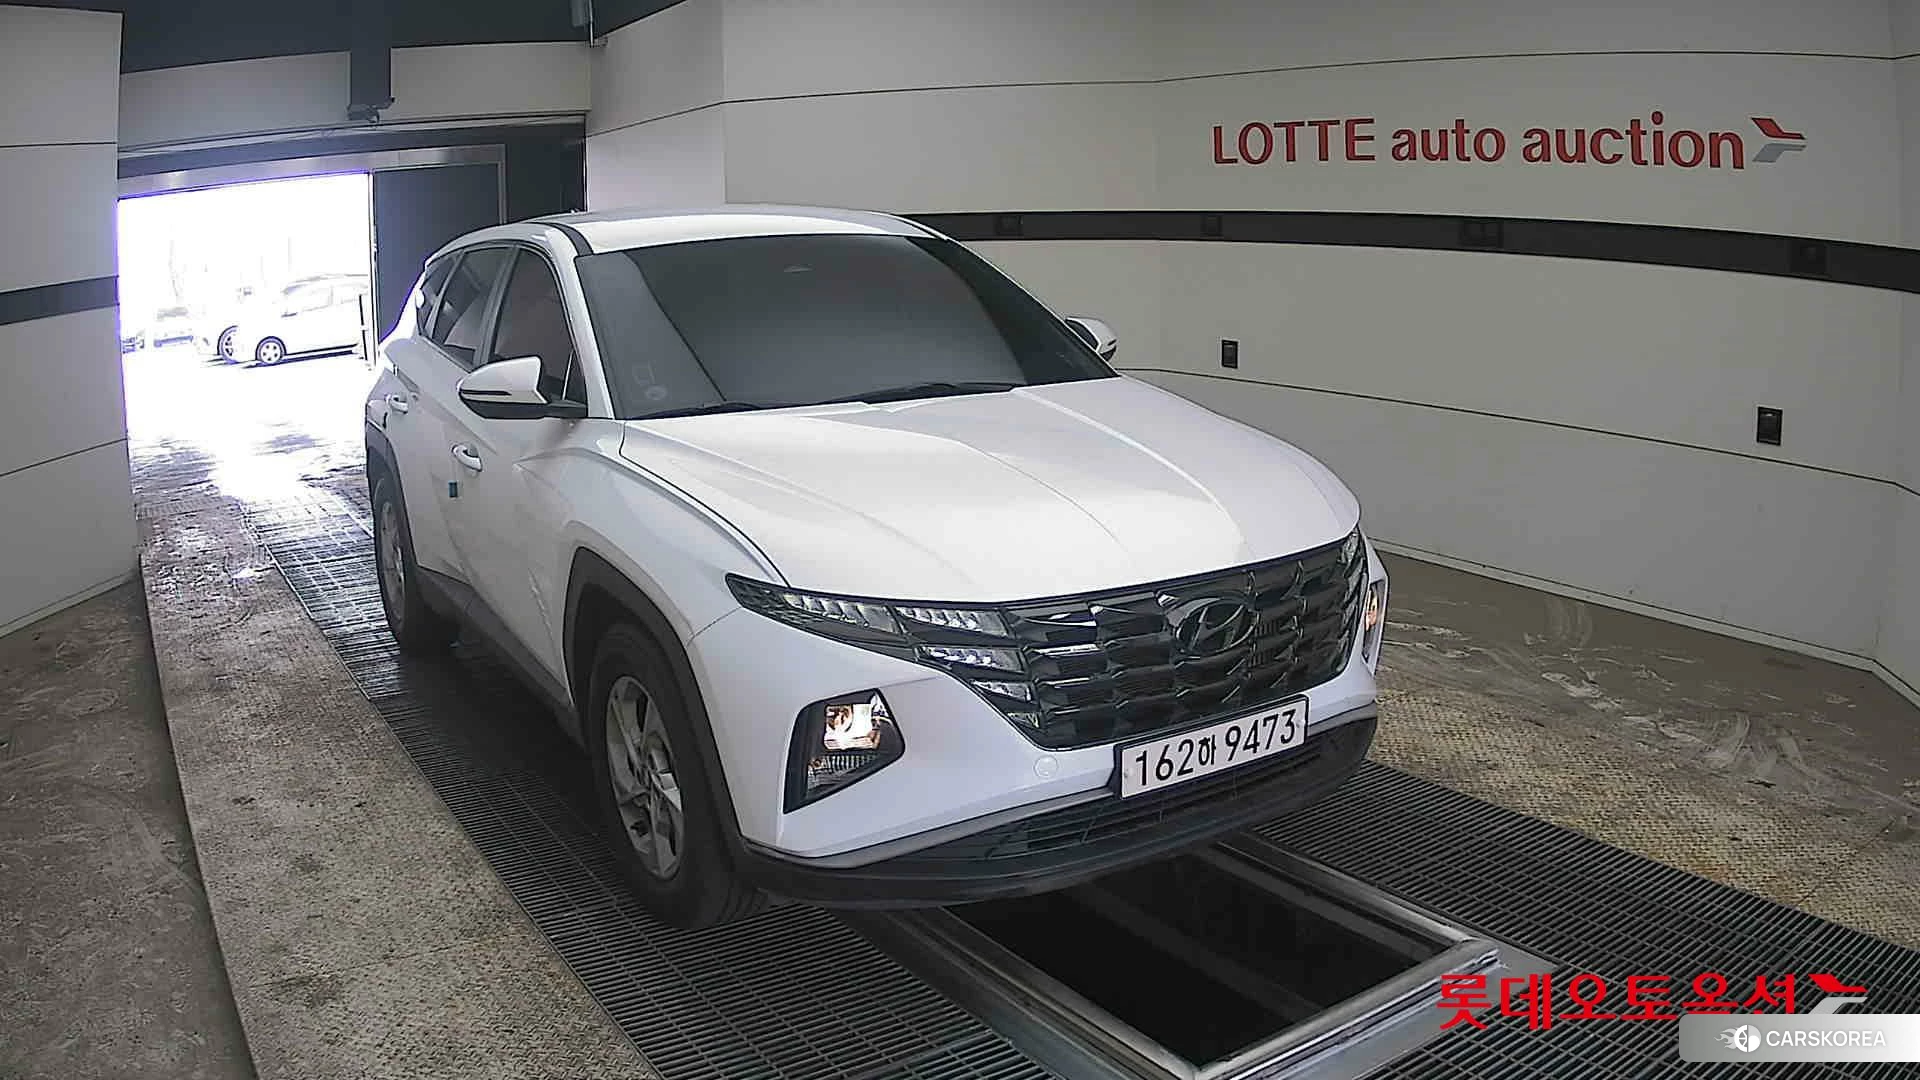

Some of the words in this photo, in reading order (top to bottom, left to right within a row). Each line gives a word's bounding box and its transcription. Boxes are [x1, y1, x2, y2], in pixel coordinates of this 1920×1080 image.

[1213, 118, 1375, 164] LOTTE
[1391, 118, 1506, 163] auto
[1522, 111, 1745, 170] auction
[1136, 735, 1216, 786] 162하
[1225, 708, 1297, 762] 9473
